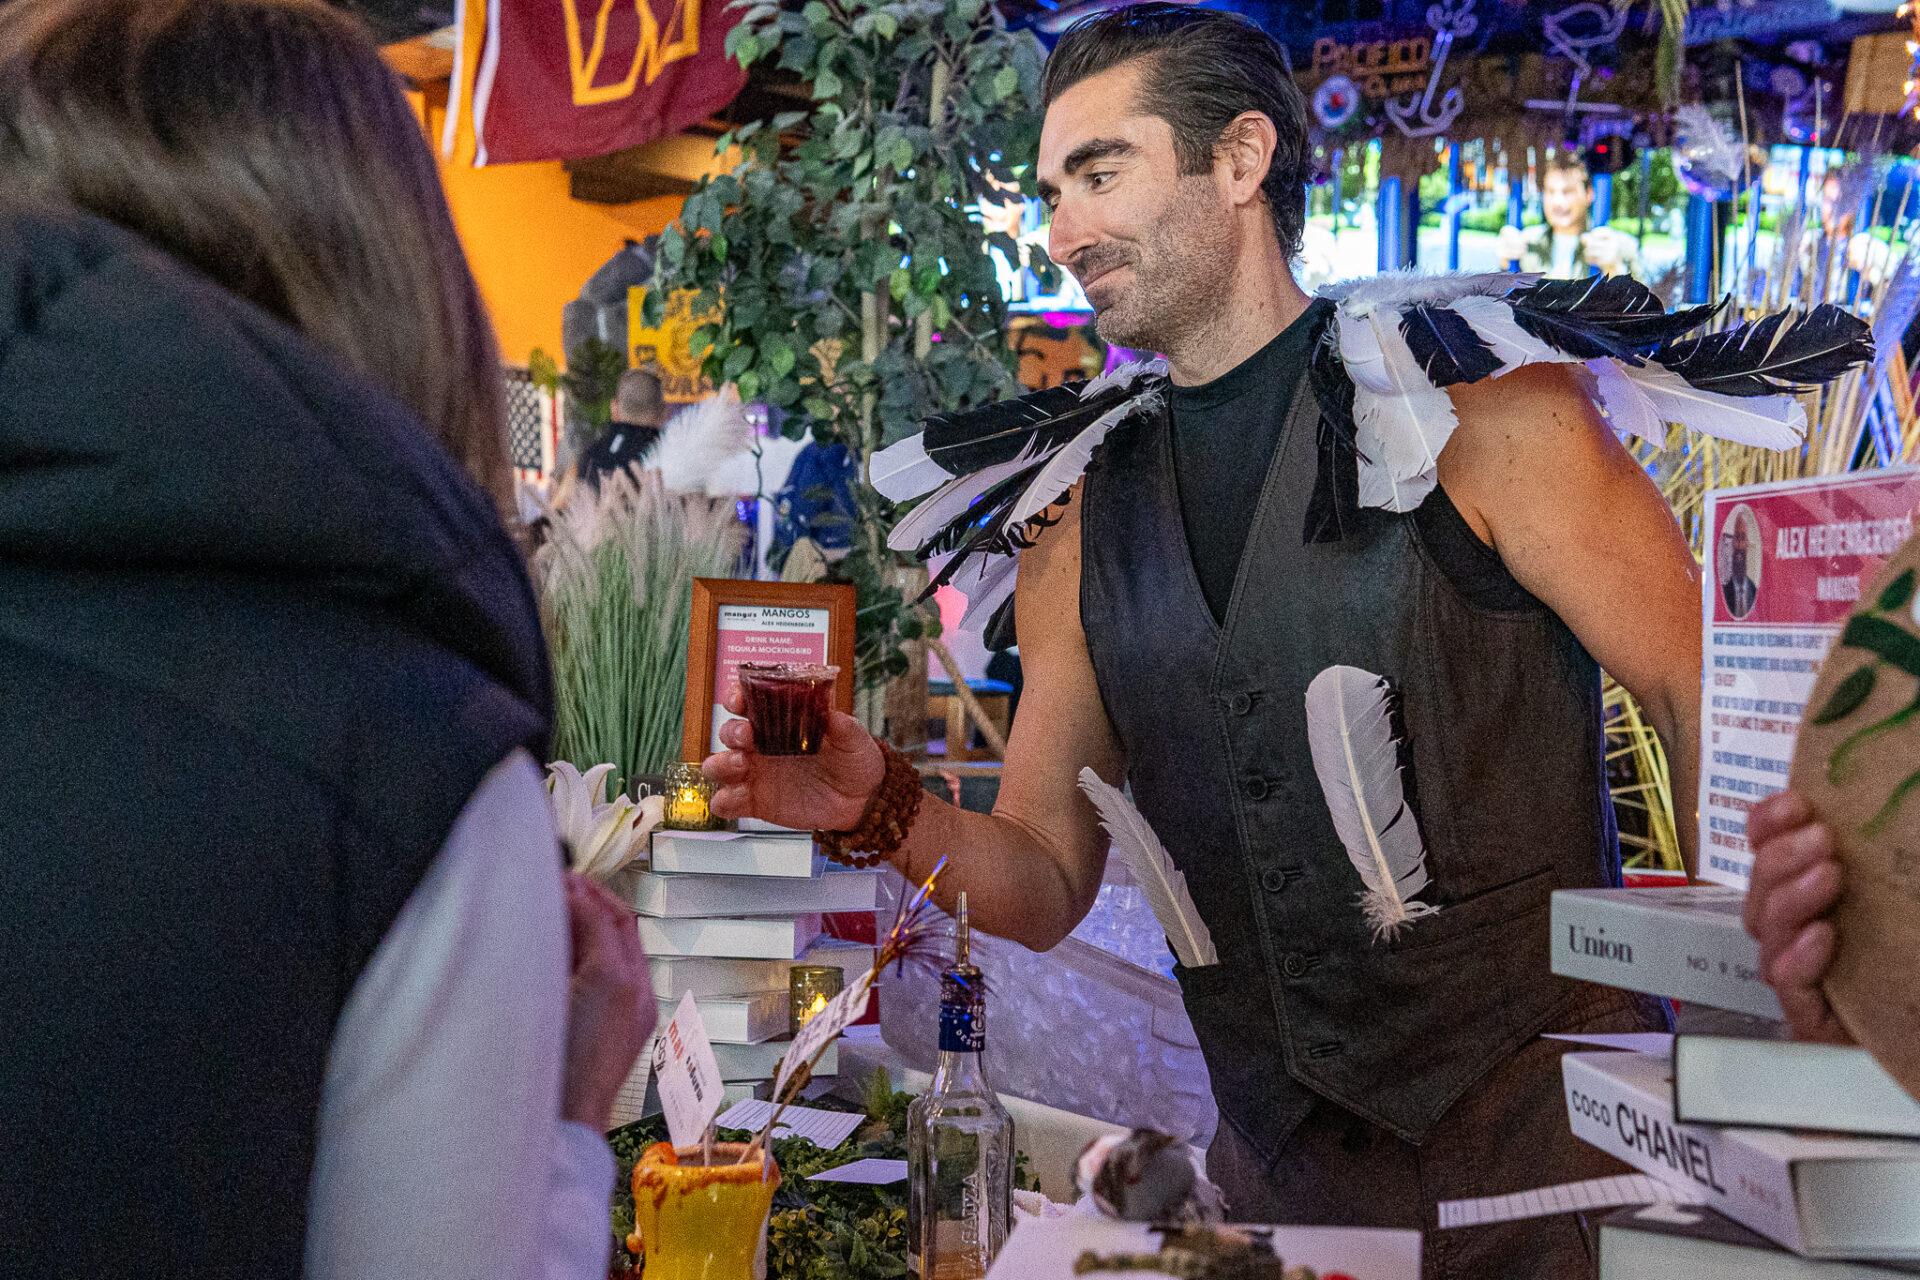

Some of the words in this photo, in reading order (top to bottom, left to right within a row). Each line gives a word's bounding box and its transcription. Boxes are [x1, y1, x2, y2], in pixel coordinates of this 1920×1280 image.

[1776, 527, 1807, 559] ALEX
[761, 608, 810, 619] MANGOS
[727, 645, 757, 653] TEQUILA
[758, 646, 813, 655] MOCKINGBIRD
[745, 636, 768, 644] DRINK
[1569, 925, 1634, 964] Union
[1571, 1089, 1612, 1127] COCO
[1616, 1102, 1728, 1196] CHANEL
